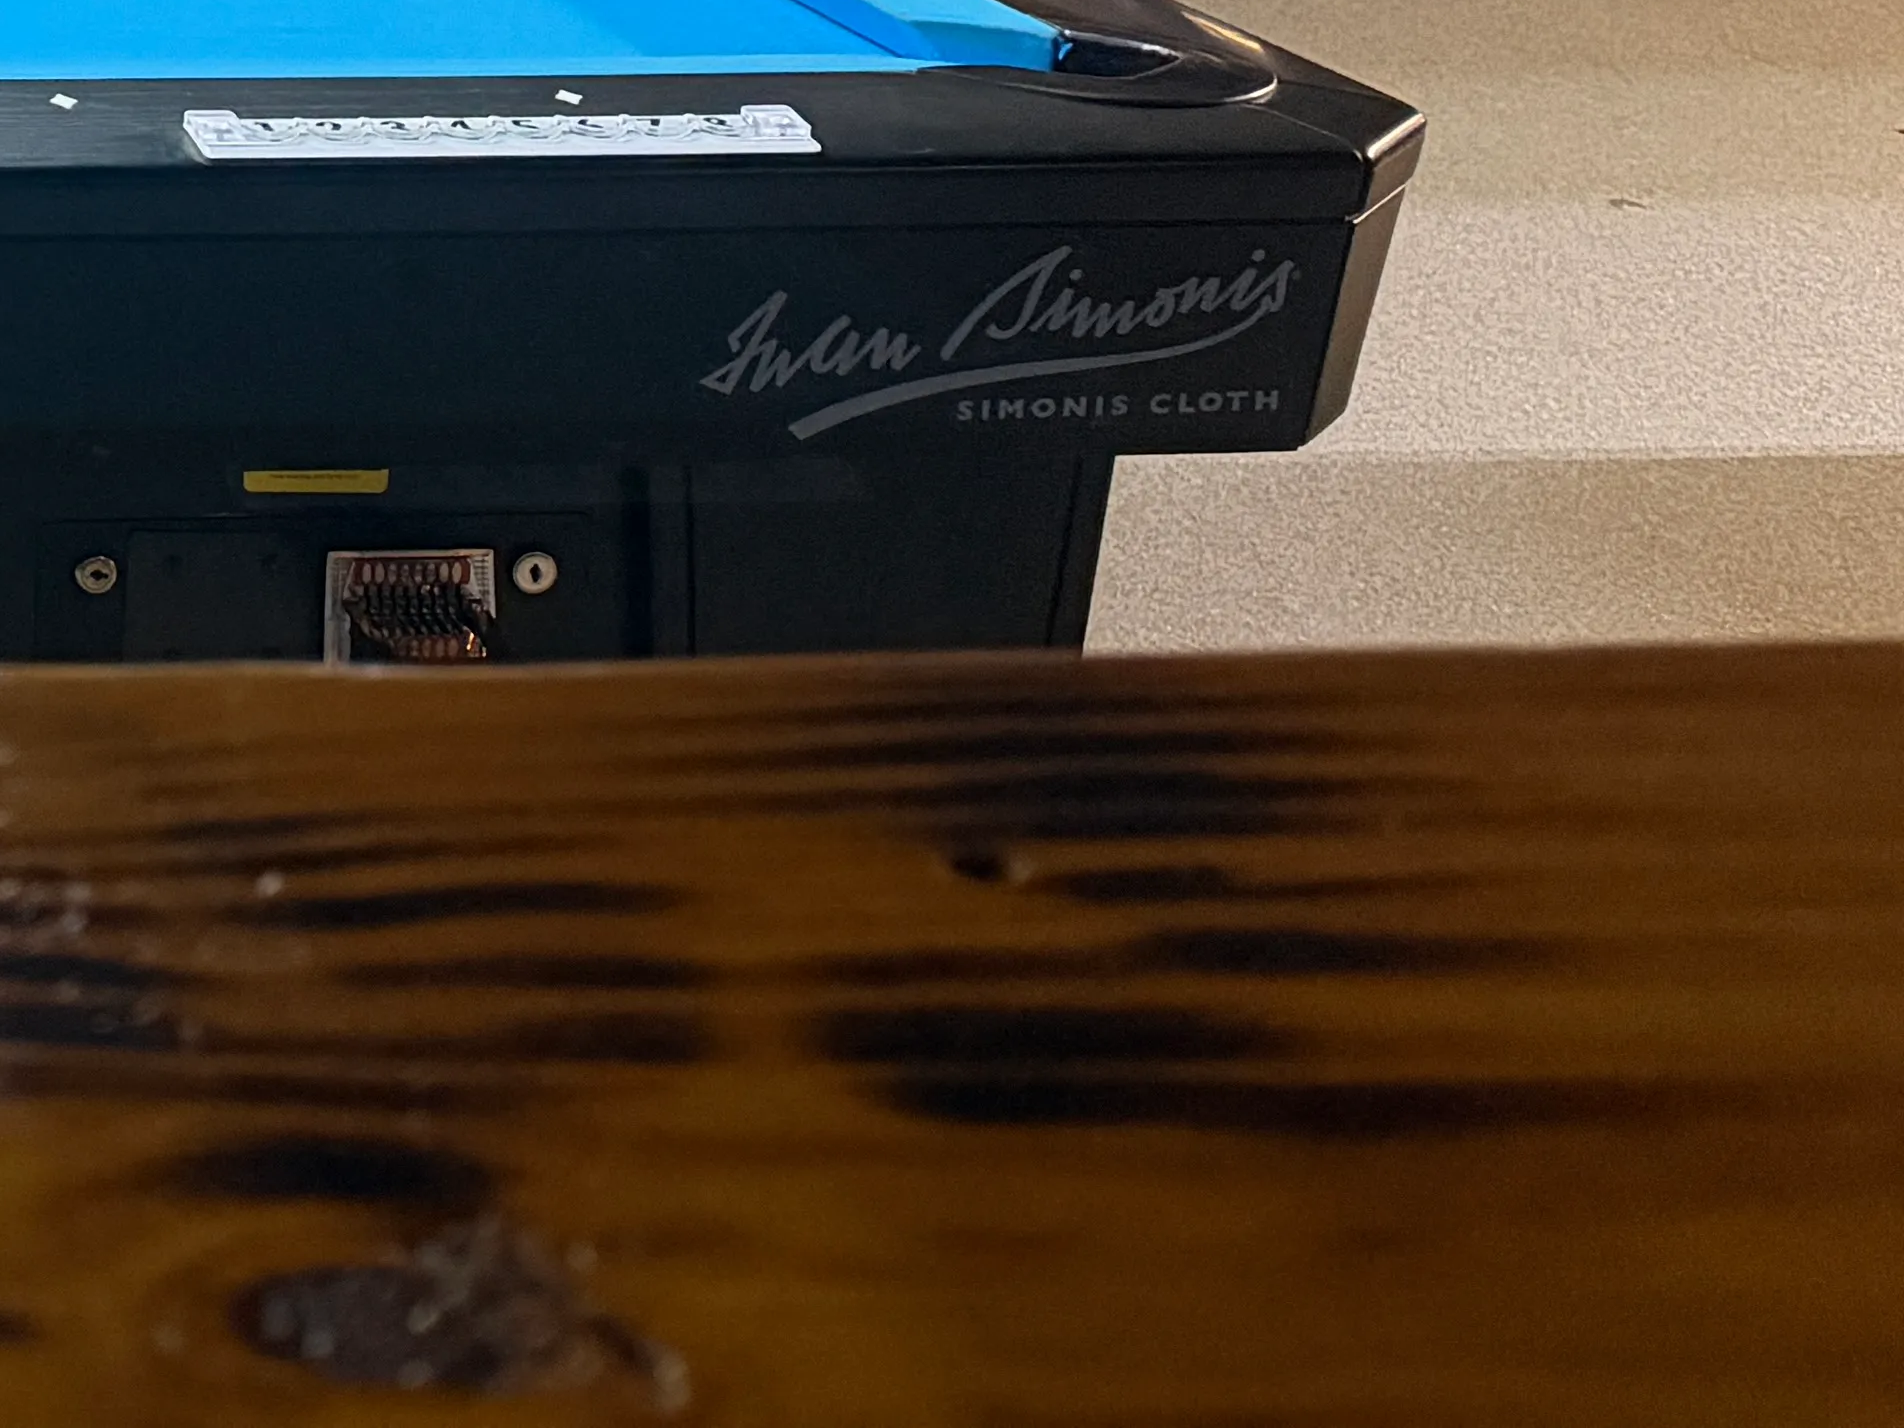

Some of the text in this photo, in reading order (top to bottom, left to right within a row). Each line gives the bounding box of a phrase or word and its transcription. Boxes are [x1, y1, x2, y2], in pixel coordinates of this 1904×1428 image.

[942, 244, 1296, 362] Simonis
[955, 389, 1281, 422] SIMONIS CLOTH
